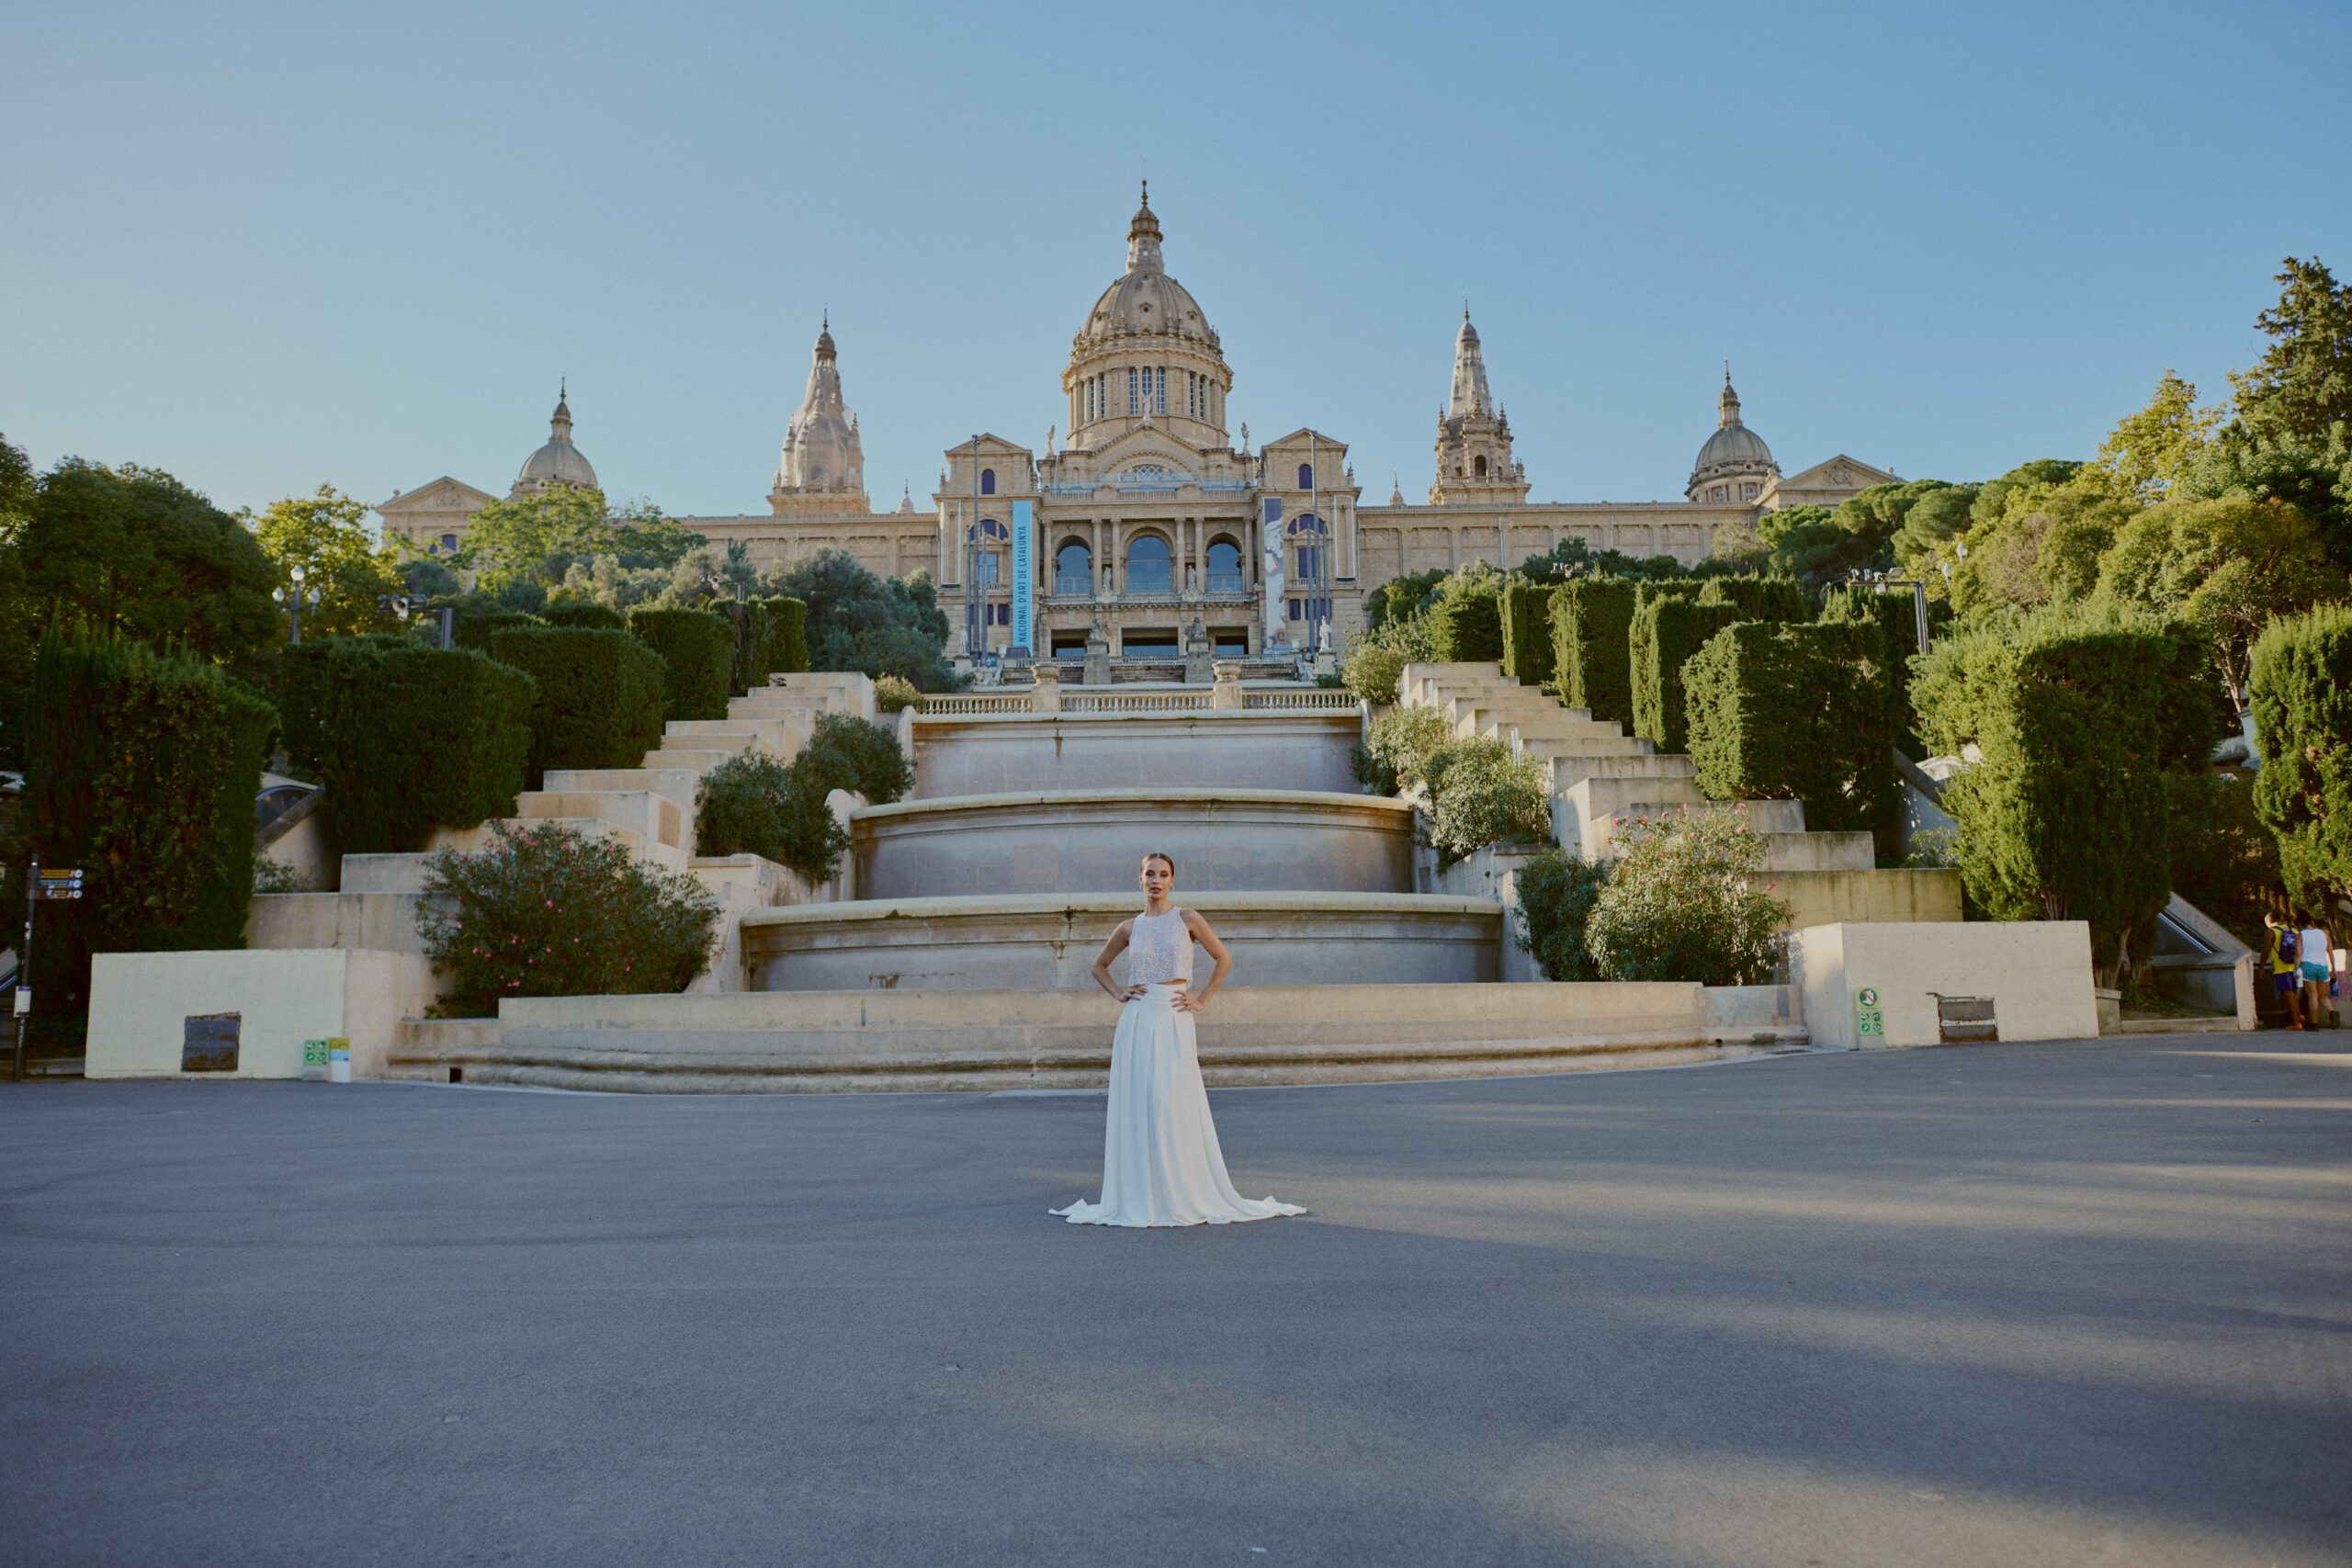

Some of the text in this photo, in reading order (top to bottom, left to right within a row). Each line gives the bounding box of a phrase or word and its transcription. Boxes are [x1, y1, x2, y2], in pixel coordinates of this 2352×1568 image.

[1017, 525, 1027, 642] NACIONAL D'ART DE CATALUNYA
